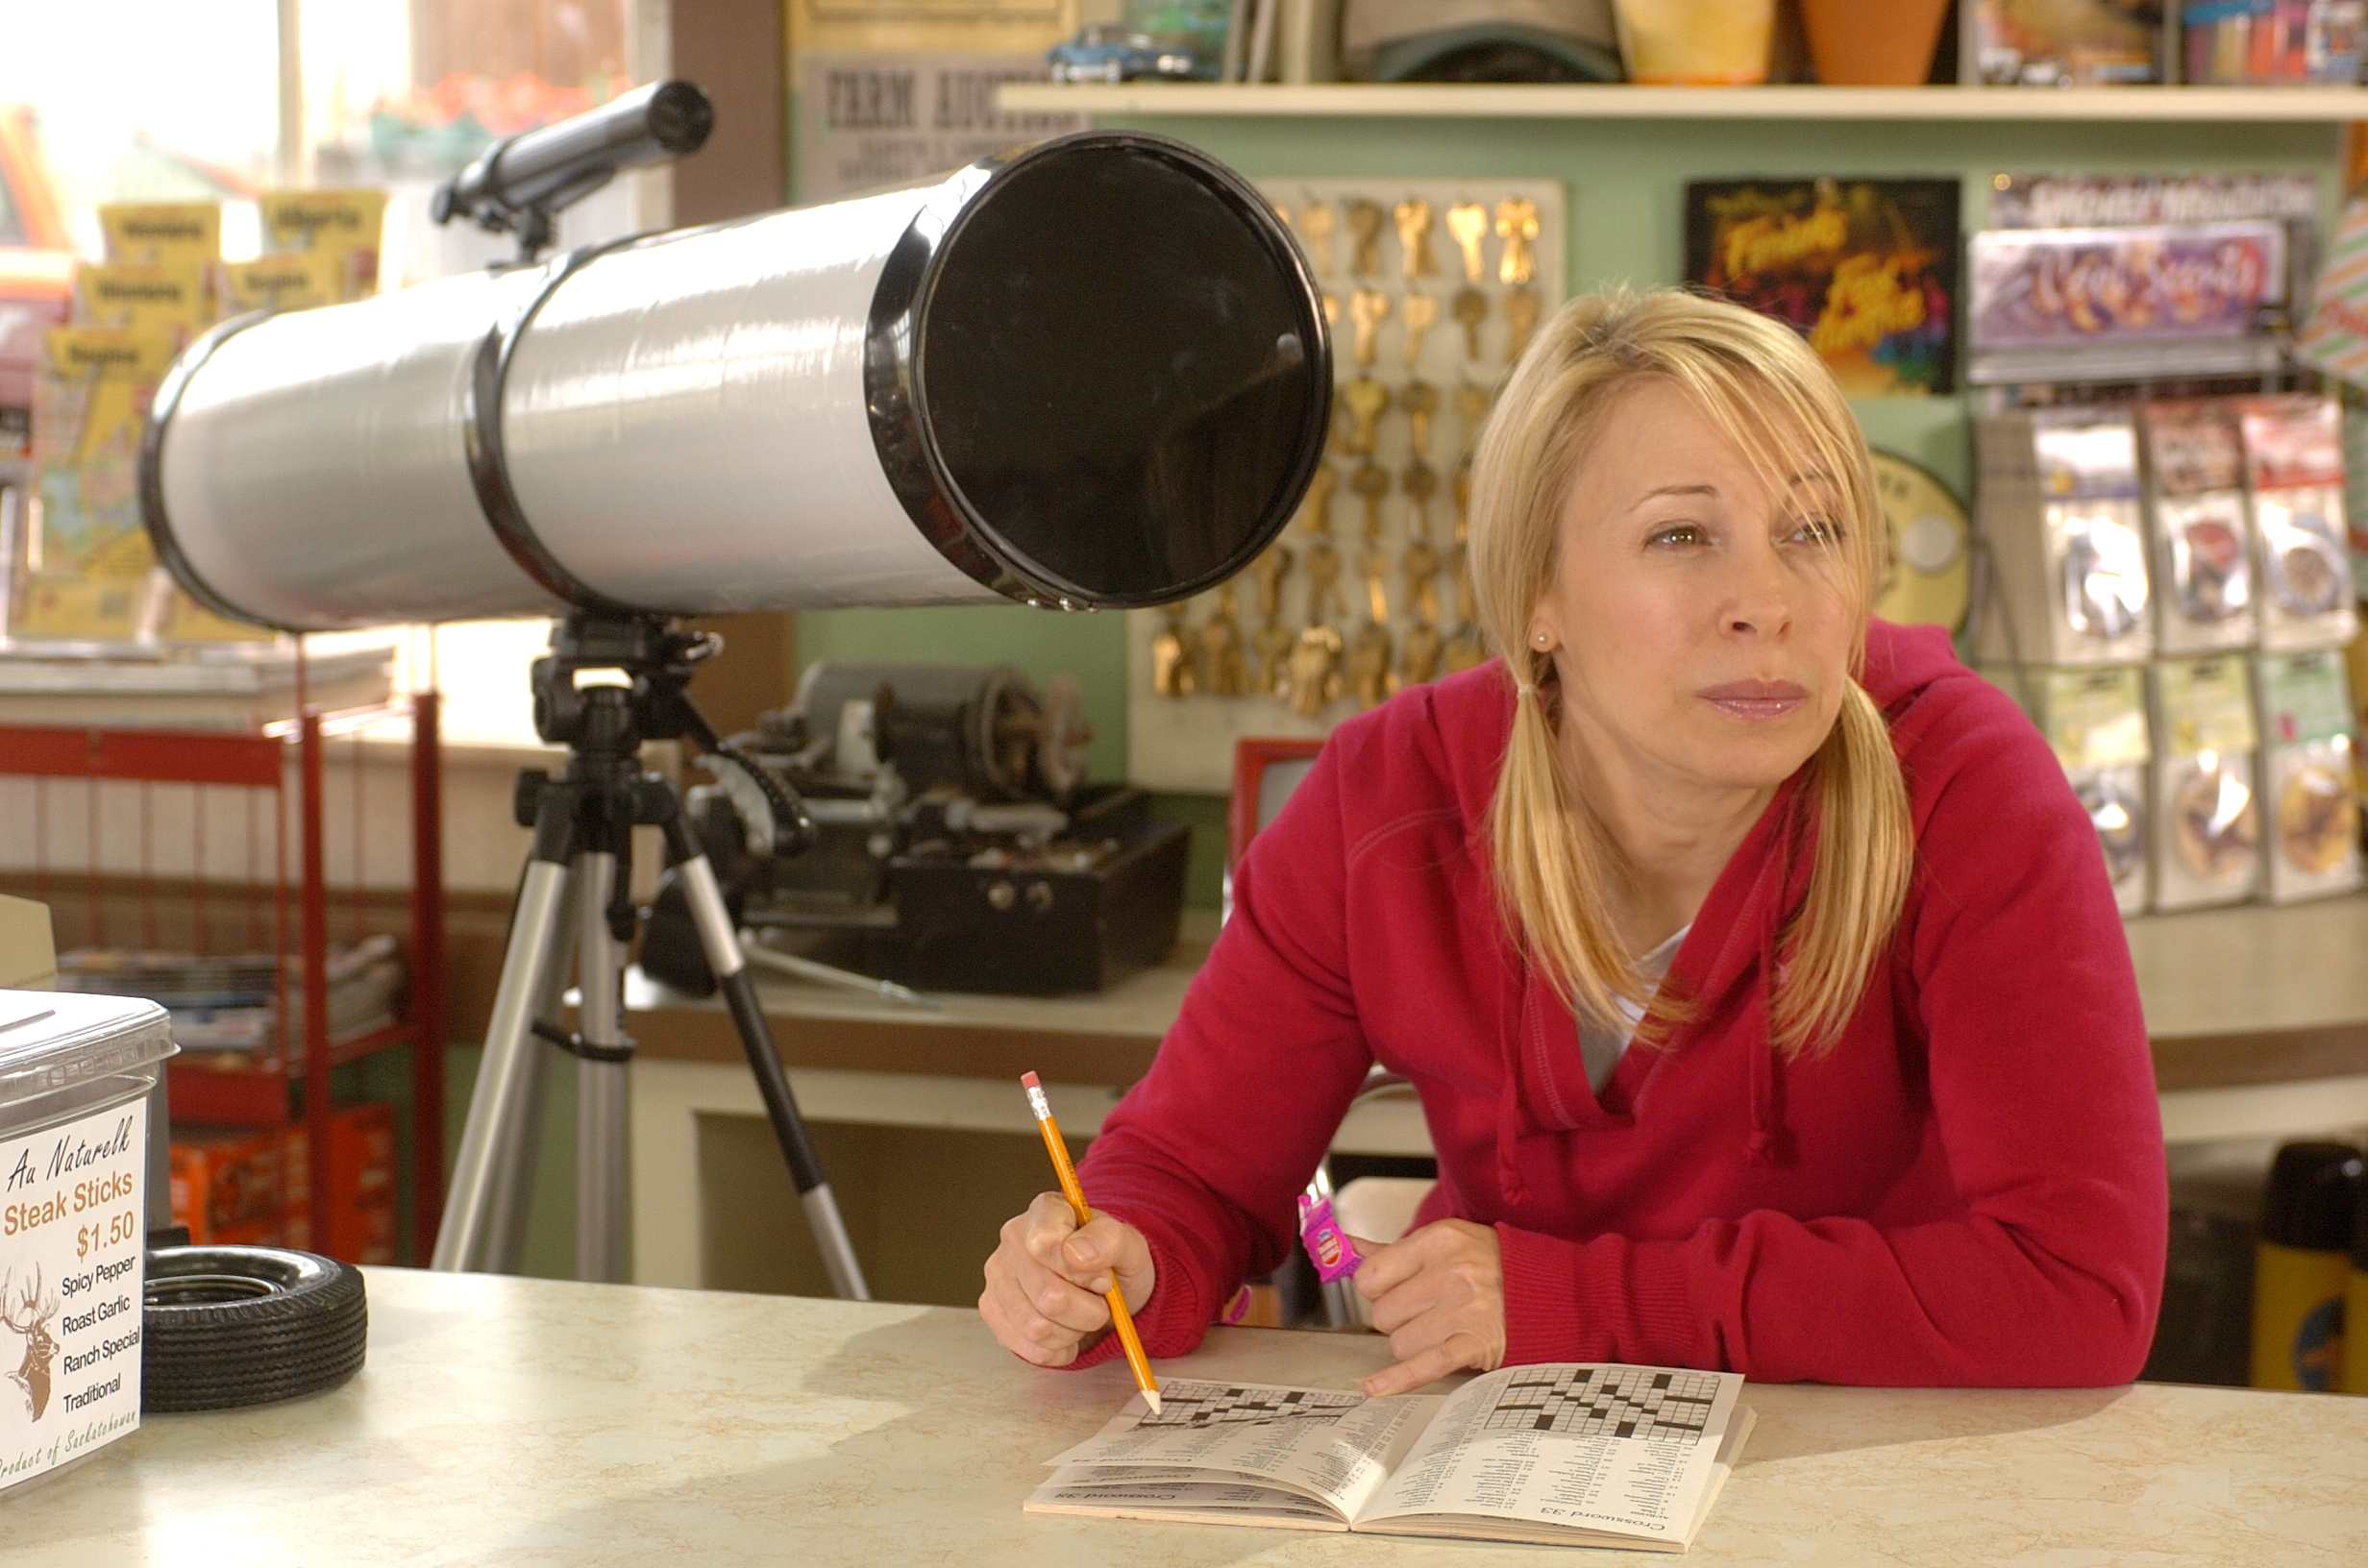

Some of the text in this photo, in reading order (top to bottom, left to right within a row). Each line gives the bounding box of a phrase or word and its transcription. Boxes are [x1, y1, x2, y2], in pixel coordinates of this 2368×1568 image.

[7, 1148, 37, 1192] Au
[4, 1170, 133, 1236] Steak Sticks
[77, 1211, 134, 1263] $1.50
[62, 1256, 136, 1298] Spicy Pepper
[62, 1295, 131, 1335] Roast Garlic
[63, 1326, 140, 1375] Ranch Special
[63, 1372, 121, 1413] Traditional
[47, 1436, 60, 1465] of
[1540, 1507, 1665, 1531] Crossword 33
